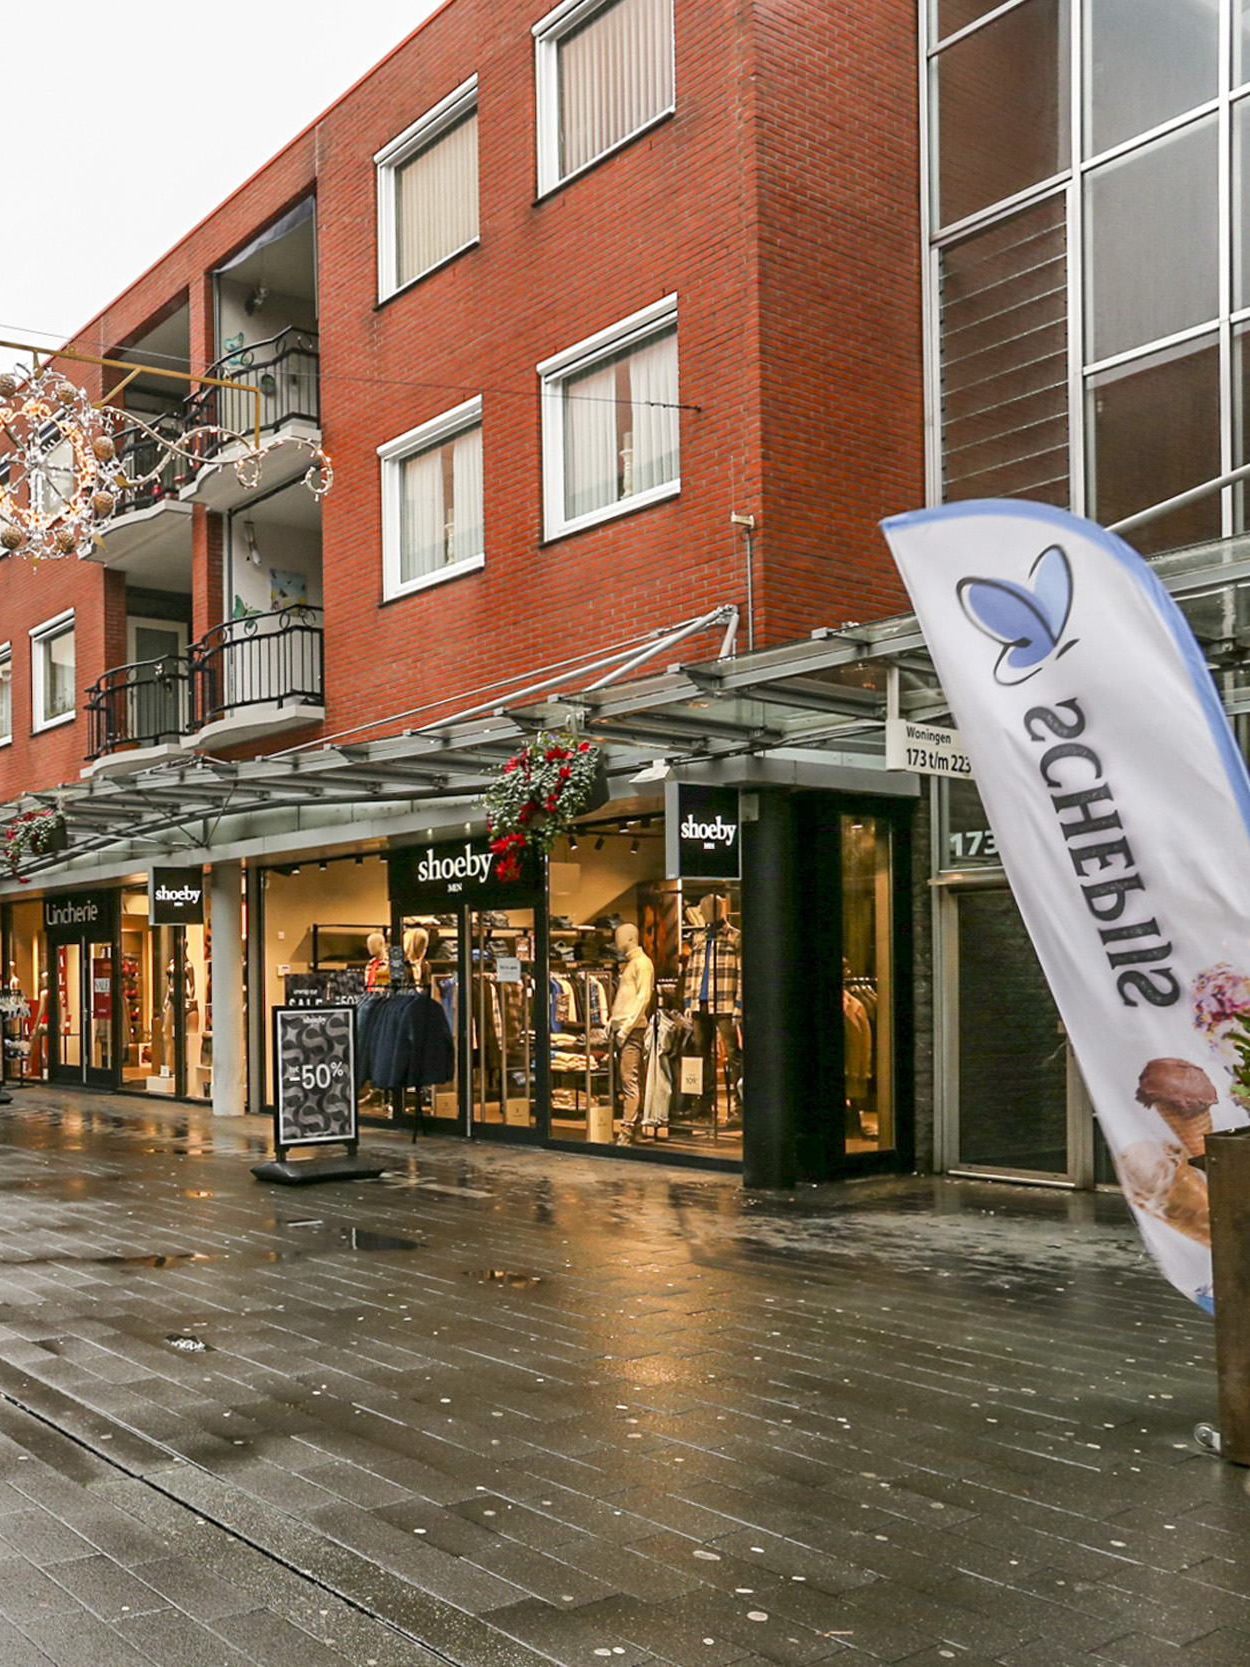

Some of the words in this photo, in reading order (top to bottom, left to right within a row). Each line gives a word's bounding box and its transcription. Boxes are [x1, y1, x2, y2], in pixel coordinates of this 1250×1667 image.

[906, 726, 952, 745] Woningen
[906, 748, 927, 767] 173
[929, 751, 949, 771] t/m
[681, 813, 737, 846] shoeby
[950, 829, 999, 857] 173
[417, 843, 494, 883] shoeby
[155, 884, 201, 904] shoeby
[447, 882, 463, 893] MEN
[46, 899, 99, 926] Lincherie
[289, 1061, 344, 1089] -50%
